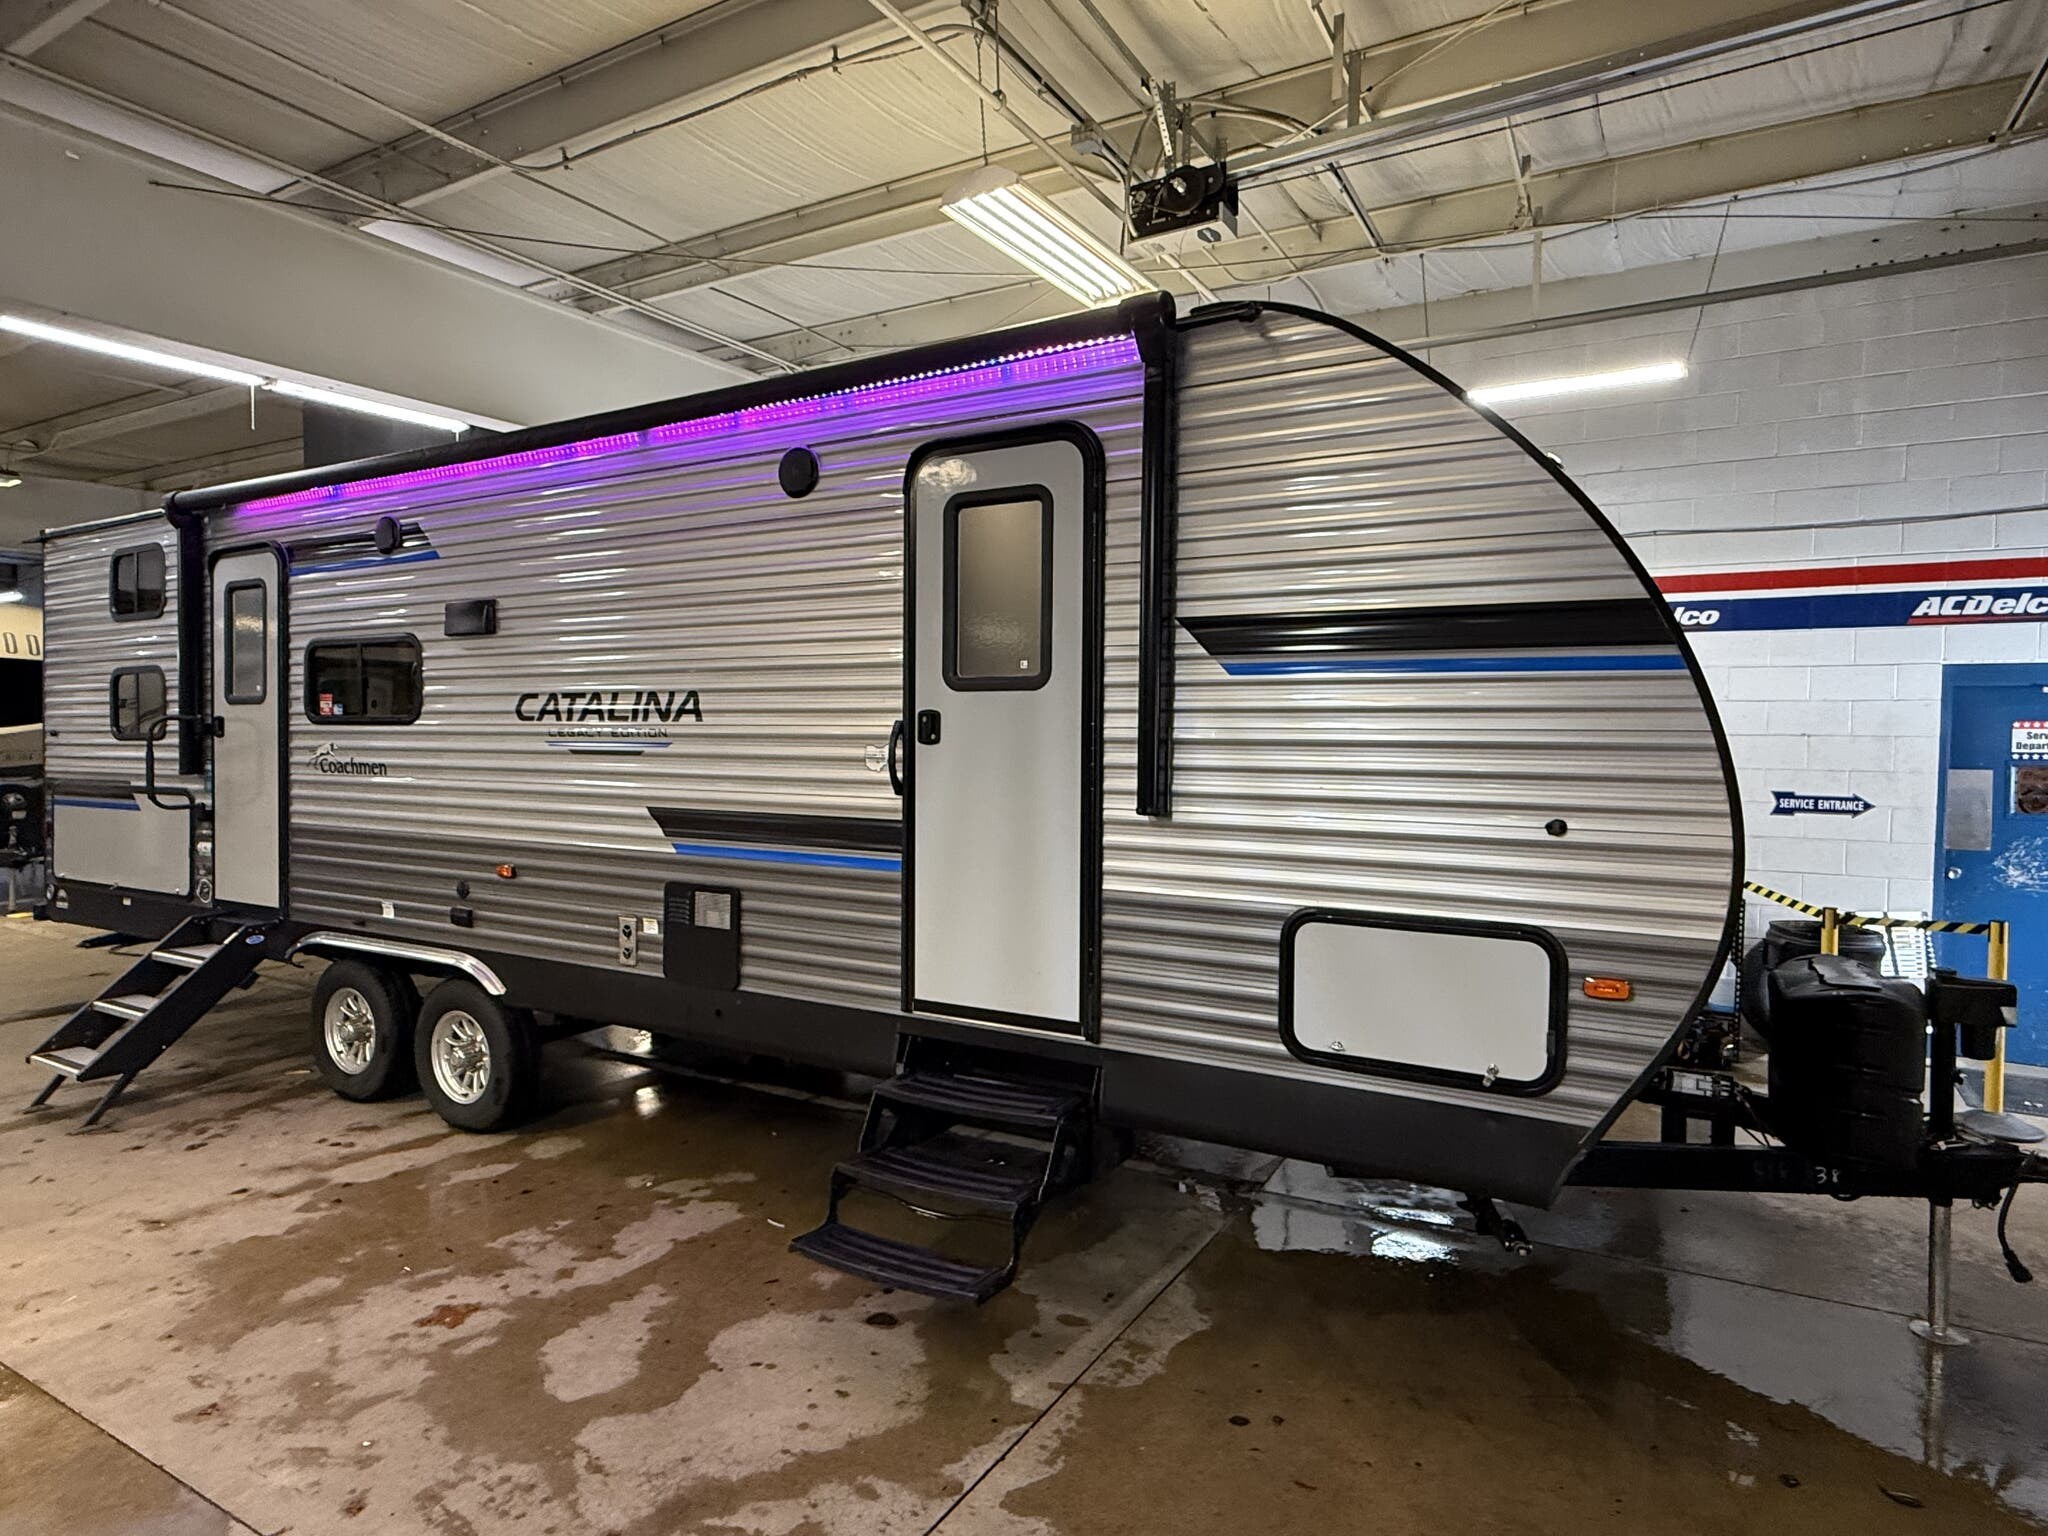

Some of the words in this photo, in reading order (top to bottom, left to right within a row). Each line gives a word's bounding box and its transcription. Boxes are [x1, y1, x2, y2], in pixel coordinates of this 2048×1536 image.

[515, 690, 703, 722] CATALINA
[320, 757, 387, 776] Coachmen
[1779, 798, 1815, 810] SERVICE
[1817, 799, 1865, 811] ENTRANCE
